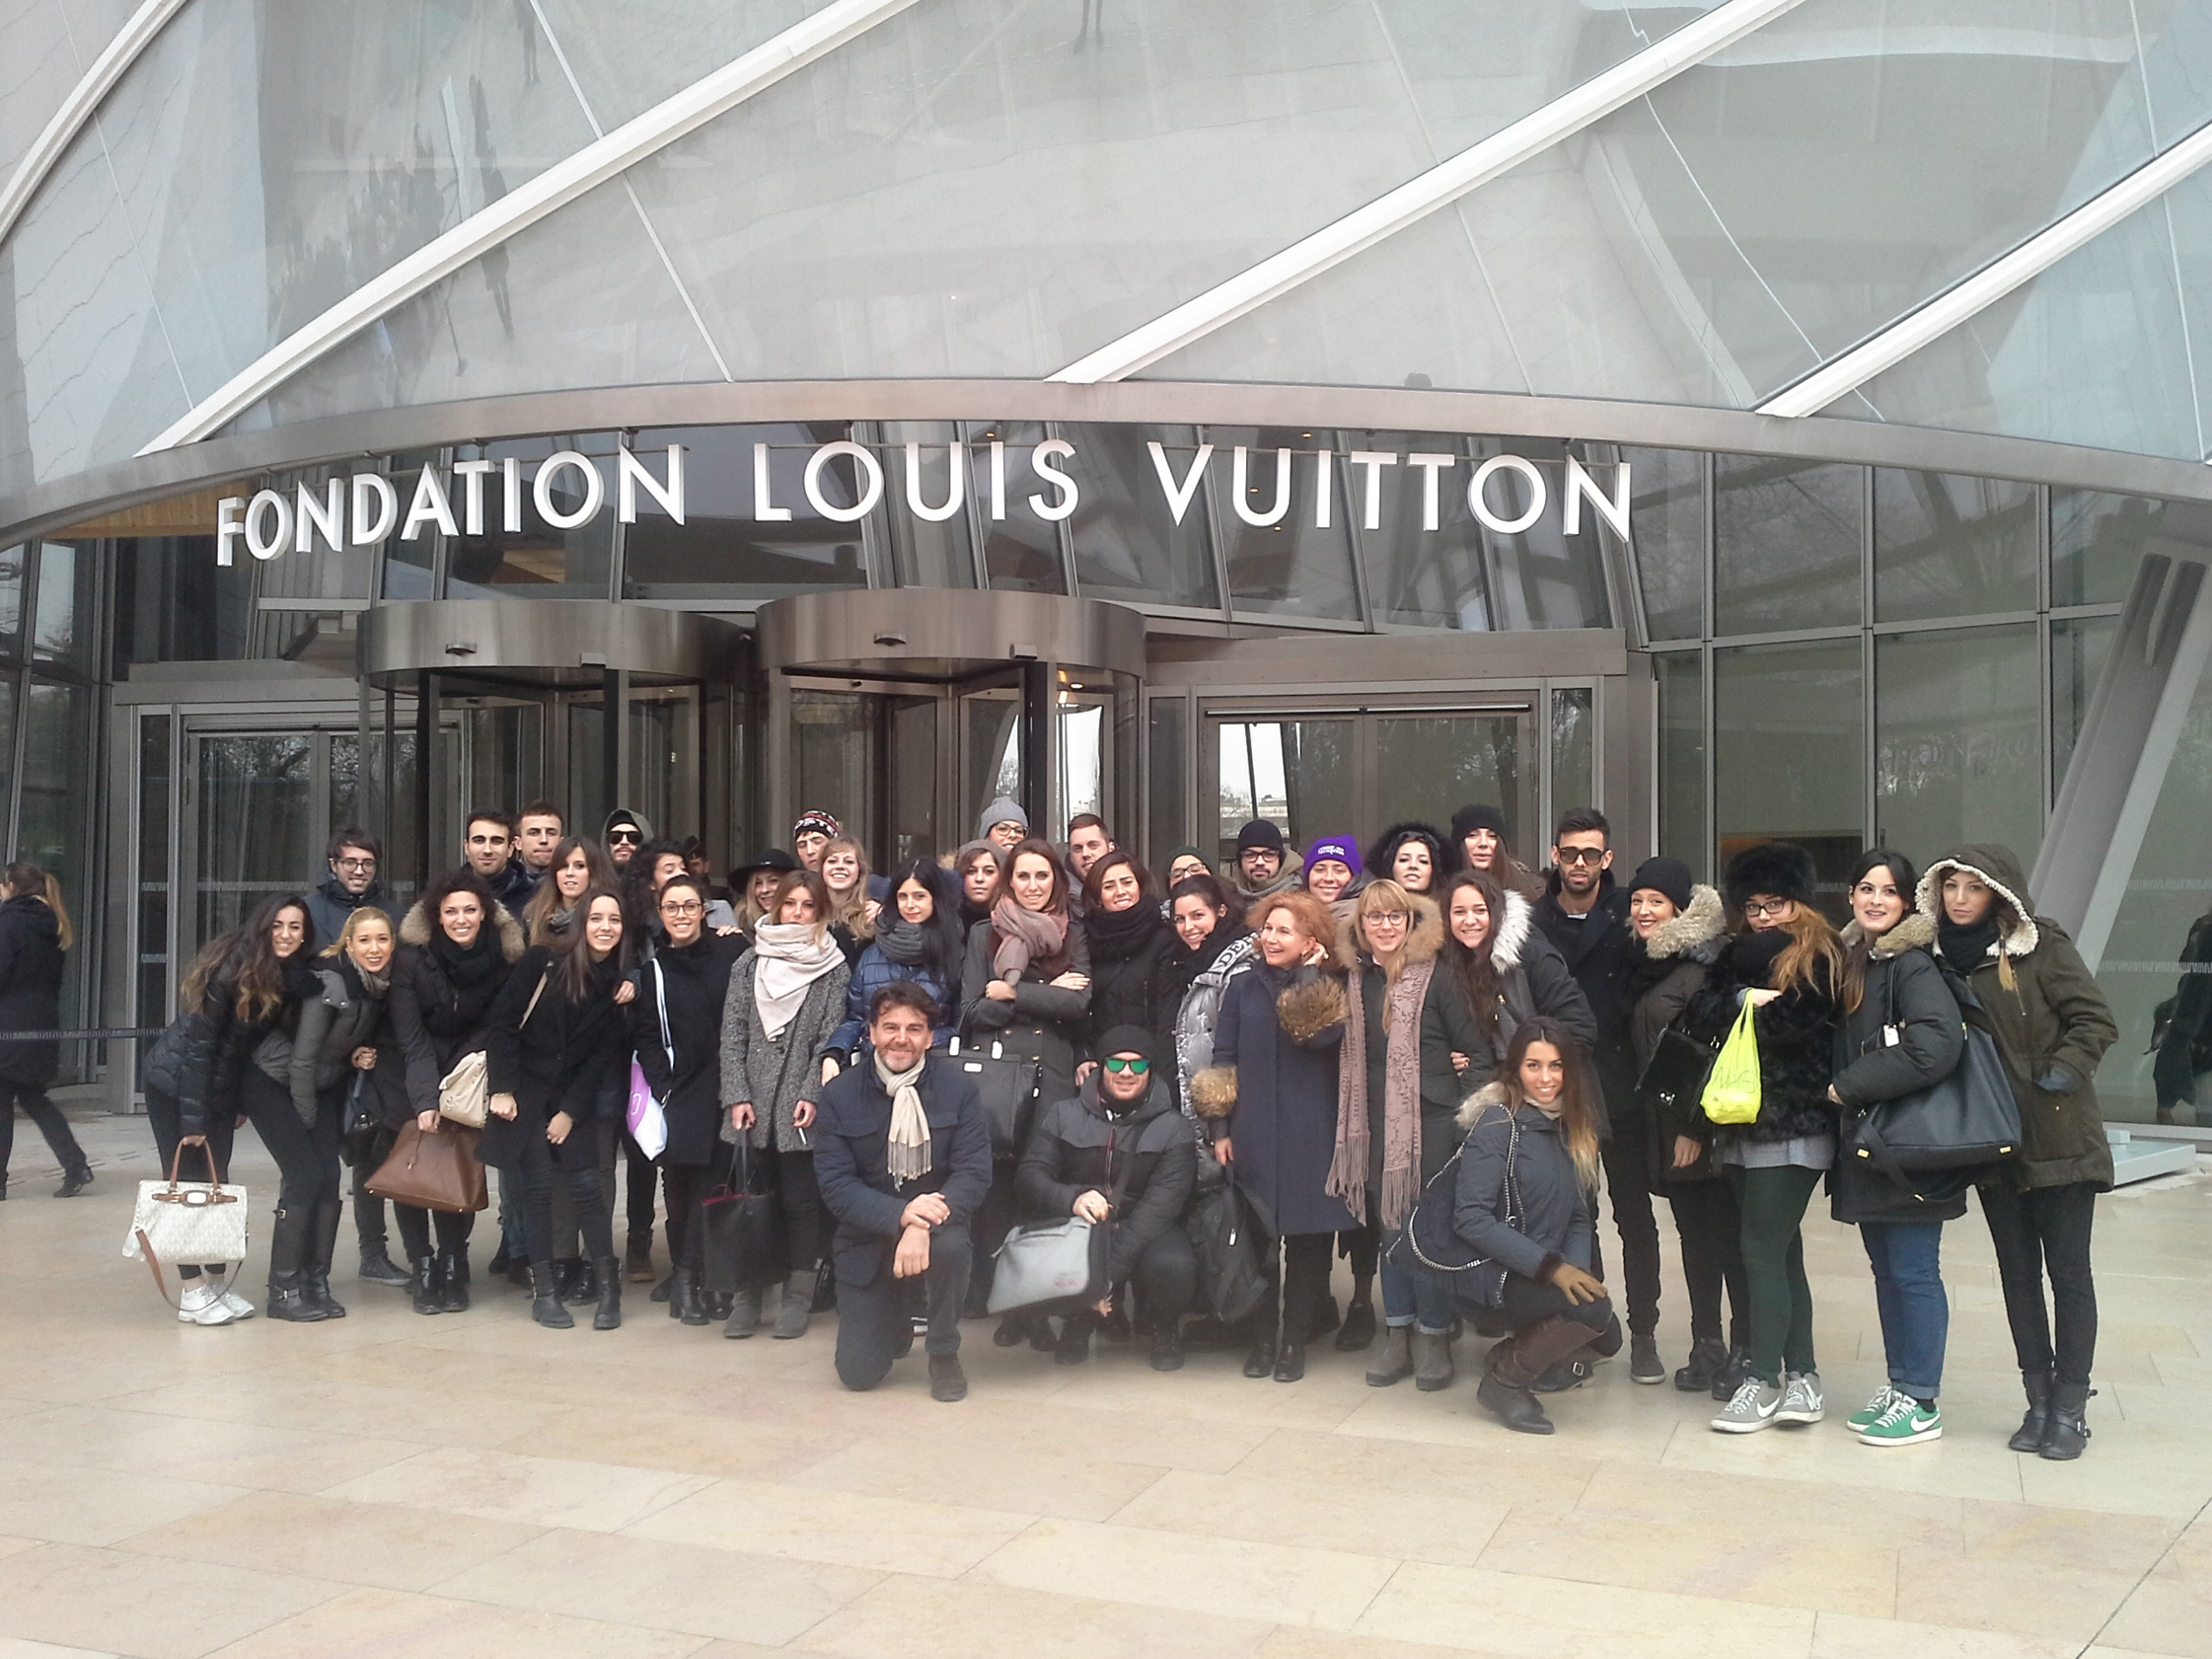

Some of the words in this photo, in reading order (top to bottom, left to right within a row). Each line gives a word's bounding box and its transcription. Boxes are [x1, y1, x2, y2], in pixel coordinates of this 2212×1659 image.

[216, 442, 687, 568] FONDATION
[753, 439, 1080, 523] LOUIS
[1146, 442, 1632, 543] VUITTON
